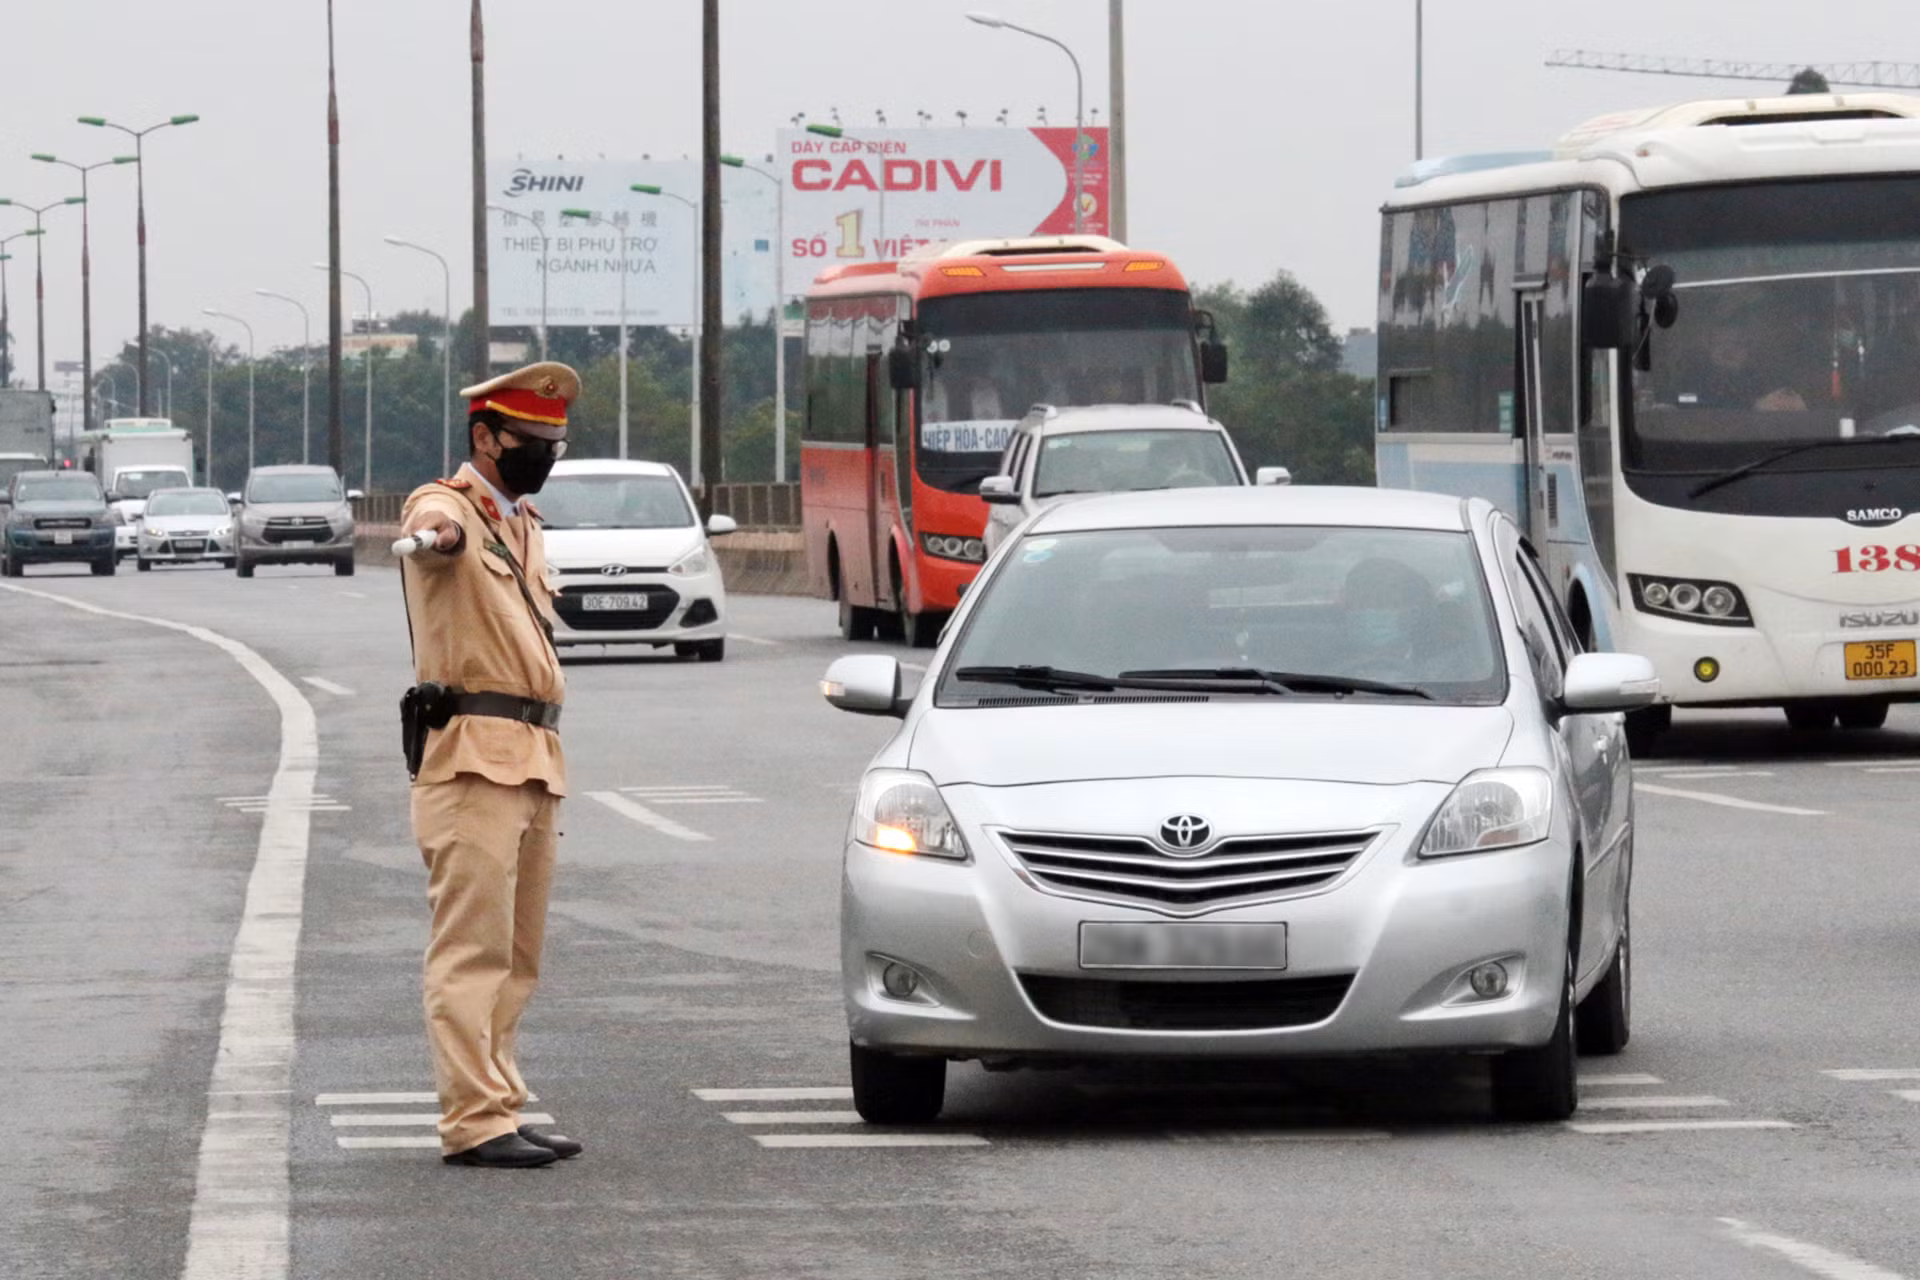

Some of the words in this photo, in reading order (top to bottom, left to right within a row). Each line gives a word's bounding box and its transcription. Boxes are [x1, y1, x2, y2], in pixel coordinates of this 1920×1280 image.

[509, 174, 585, 193] SHINI
[791, 159, 1003, 192] CADIVI
[791, 230, 828, 257] SỐ
[835, 210, 866, 258] 1
[579, 236, 615, 254] PHỤ
[1846, 507, 1903, 522] SAMCO
[1830, 543, 1920, 574] 138
[1839, 610, 1918, 629] ISUZU
[1852, 660, 1909, 677] 000.23
